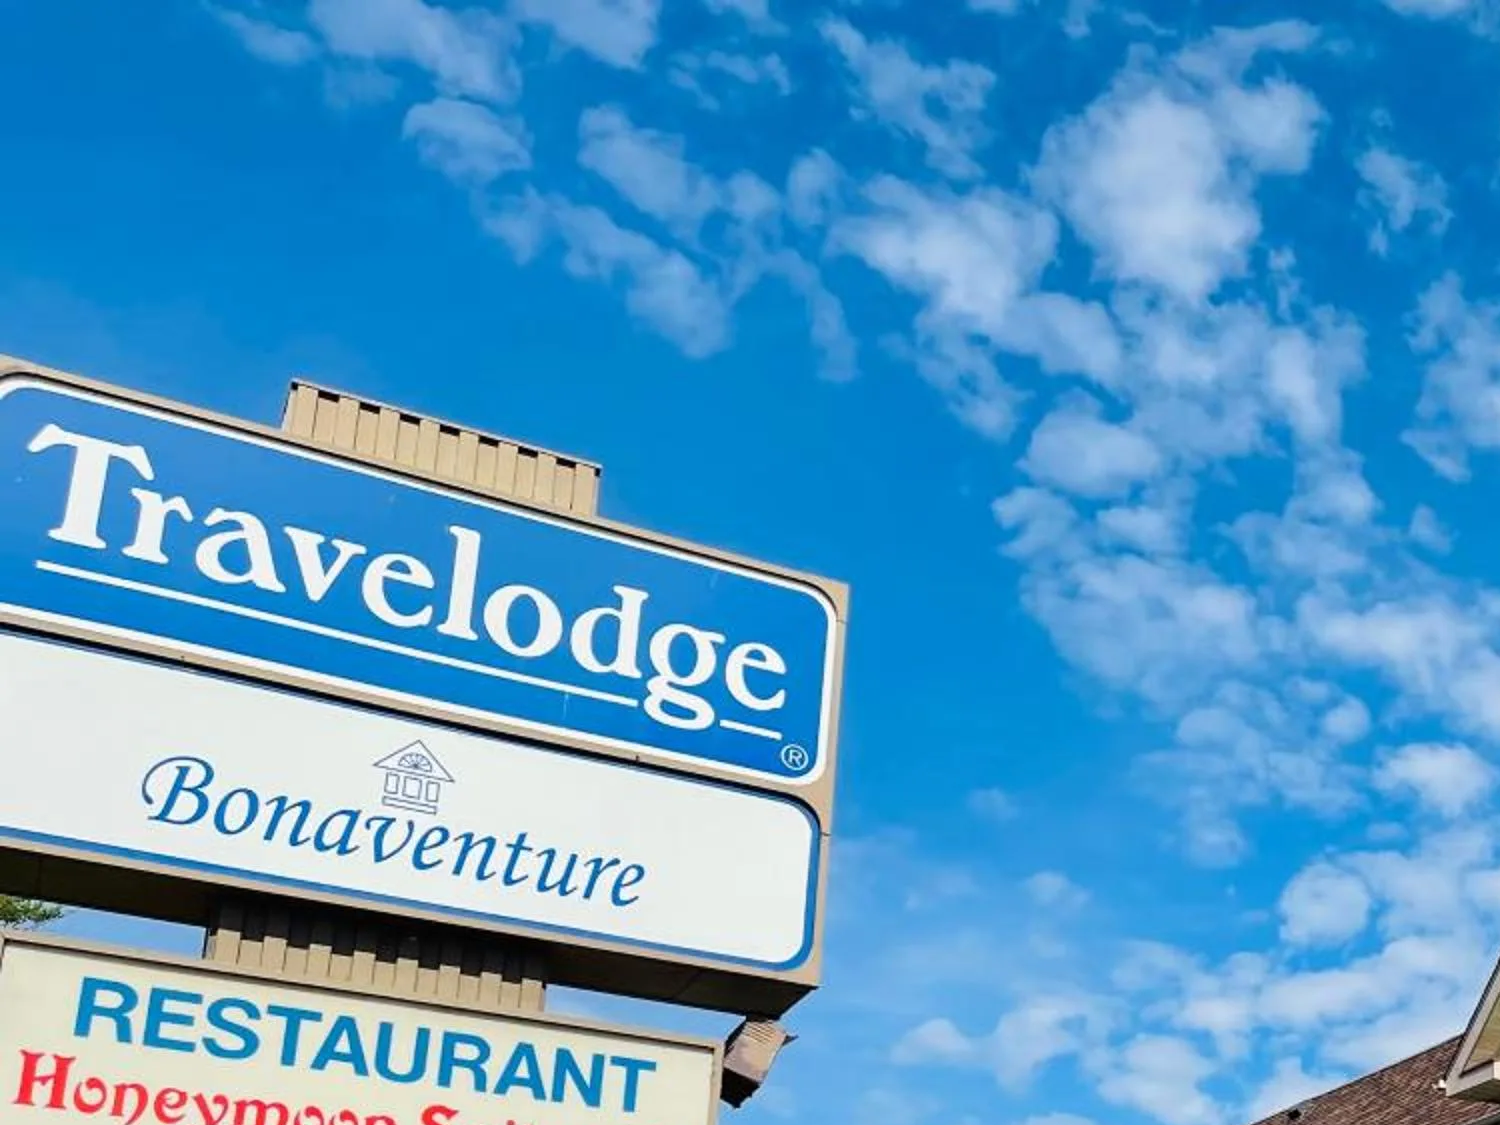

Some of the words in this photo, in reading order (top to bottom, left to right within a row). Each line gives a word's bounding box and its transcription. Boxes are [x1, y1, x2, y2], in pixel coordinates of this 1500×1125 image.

[26, 422, 787, 731] Travelodge
[141, 755, 647, 907] Bonaventure
[73, 976, 657, 1113] RESTAURANT
